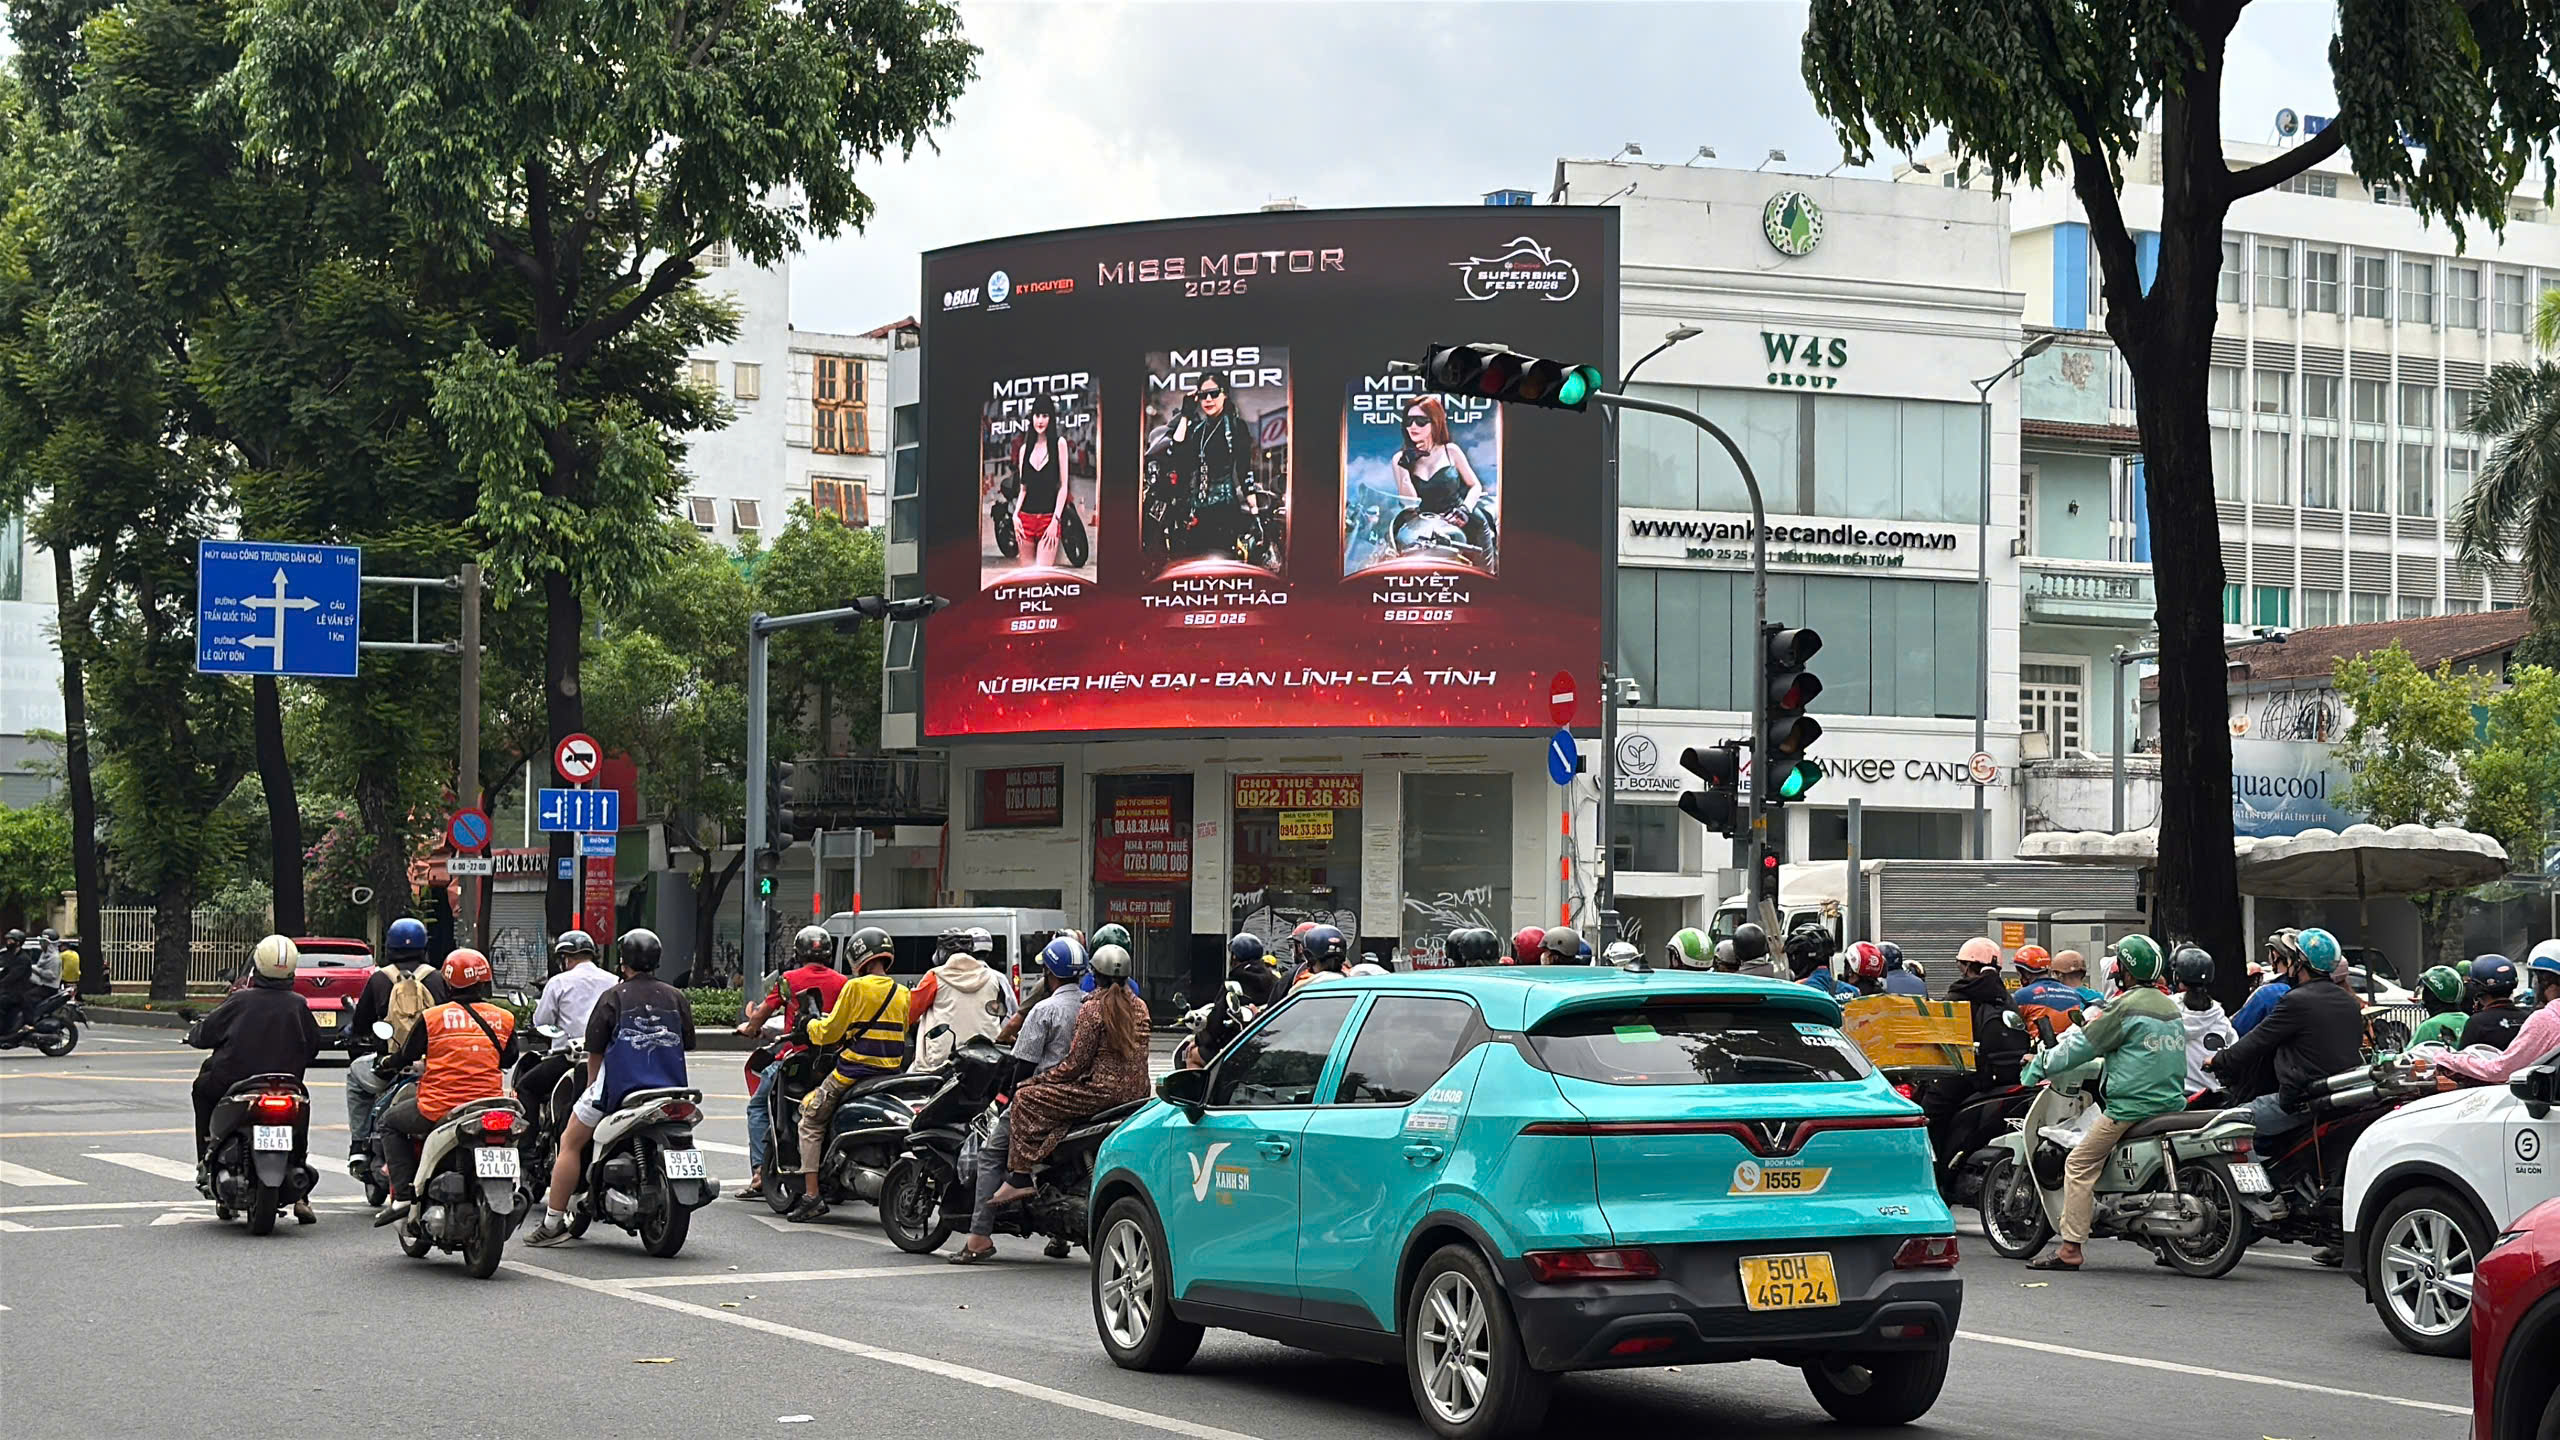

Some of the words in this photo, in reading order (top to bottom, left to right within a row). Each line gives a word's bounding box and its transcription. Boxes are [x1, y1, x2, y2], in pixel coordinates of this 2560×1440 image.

[1098, 257, 1186, 286] MISS
[1200, 248, 1346, 278] MOTOR
[1477, 271, 1568, 280] SUPERBIKE
[1185, 279, 1248, 298] 2026
[1485, 281, 1525, 290] FEST
[1526, 281, 1559, 290] 2026
[1170, 346, 1260, 368] MISS
[1760, 331, 1848, 368] W4S
[992, 371, 1090, 400] MOTOR
[1149, 368, 1283, 392] MOOR
[1767, 372, 1838, 390] GROUP
[1353, 394, 1492, 411] SECND
[994, 585, 1016, 600] ÚT
[1017, 581, 1081, 599] HOÀNG
[1172, 578, 1253, 592] HUỲNH
[1020, 600, 1053, 613] PKL
[1141, 594, 1220, 608] THANH
[1223, 589, 1289, 606] THẢO
[1010, 619, 1035, 632] SBD
[1038, 618, 1058, 631] 010
[1183, 613, 1217, 626] SBD
[1219, 612, 1248, 625] 026
[1384, 609, 1421, 622] SBD
[1423, 609, 1453, 622] 005
[333, 631, 345, 642] Km
[1011, 676, 1080, 693] BIKER
[1085, 671, 1145, 694] HIỆN
[1150, 672, 1197, 692] ĐẠI
[1371, 665, 1414, 686] CÁ
[1239, 777, 1272, 789] CHO
[1276, 776, 1315, 789] THUÊ
[1630, 777, 1681, 790] BOTANIC
[2232, 770, 2326, 804] quacool
[1237, 789, 1361, 807] 0922.16.36.36
[2233, 810, 2255, 820] ATER
[2311, 813, 2328, 823] LIFE
[522, 853, 550, 872] EYEW
[1123, 853, 1148, 871] 0703
[1149, 853, 1168, 871] 000
[1170, 853, 1189, 872] 008
[2121, 947, 2138, 967] Grab
[2143, 1027, 2186, 1052] Grab
[1215, 1171, 1237, 1190] XANH
[1238, 1173, 1250, 1191] SM
[1764, 1171, 1802, 1190] 1555
[1767, 1257, 1809, 1281] 50H
[1757, 1281, 1829, 1307] 467.24
